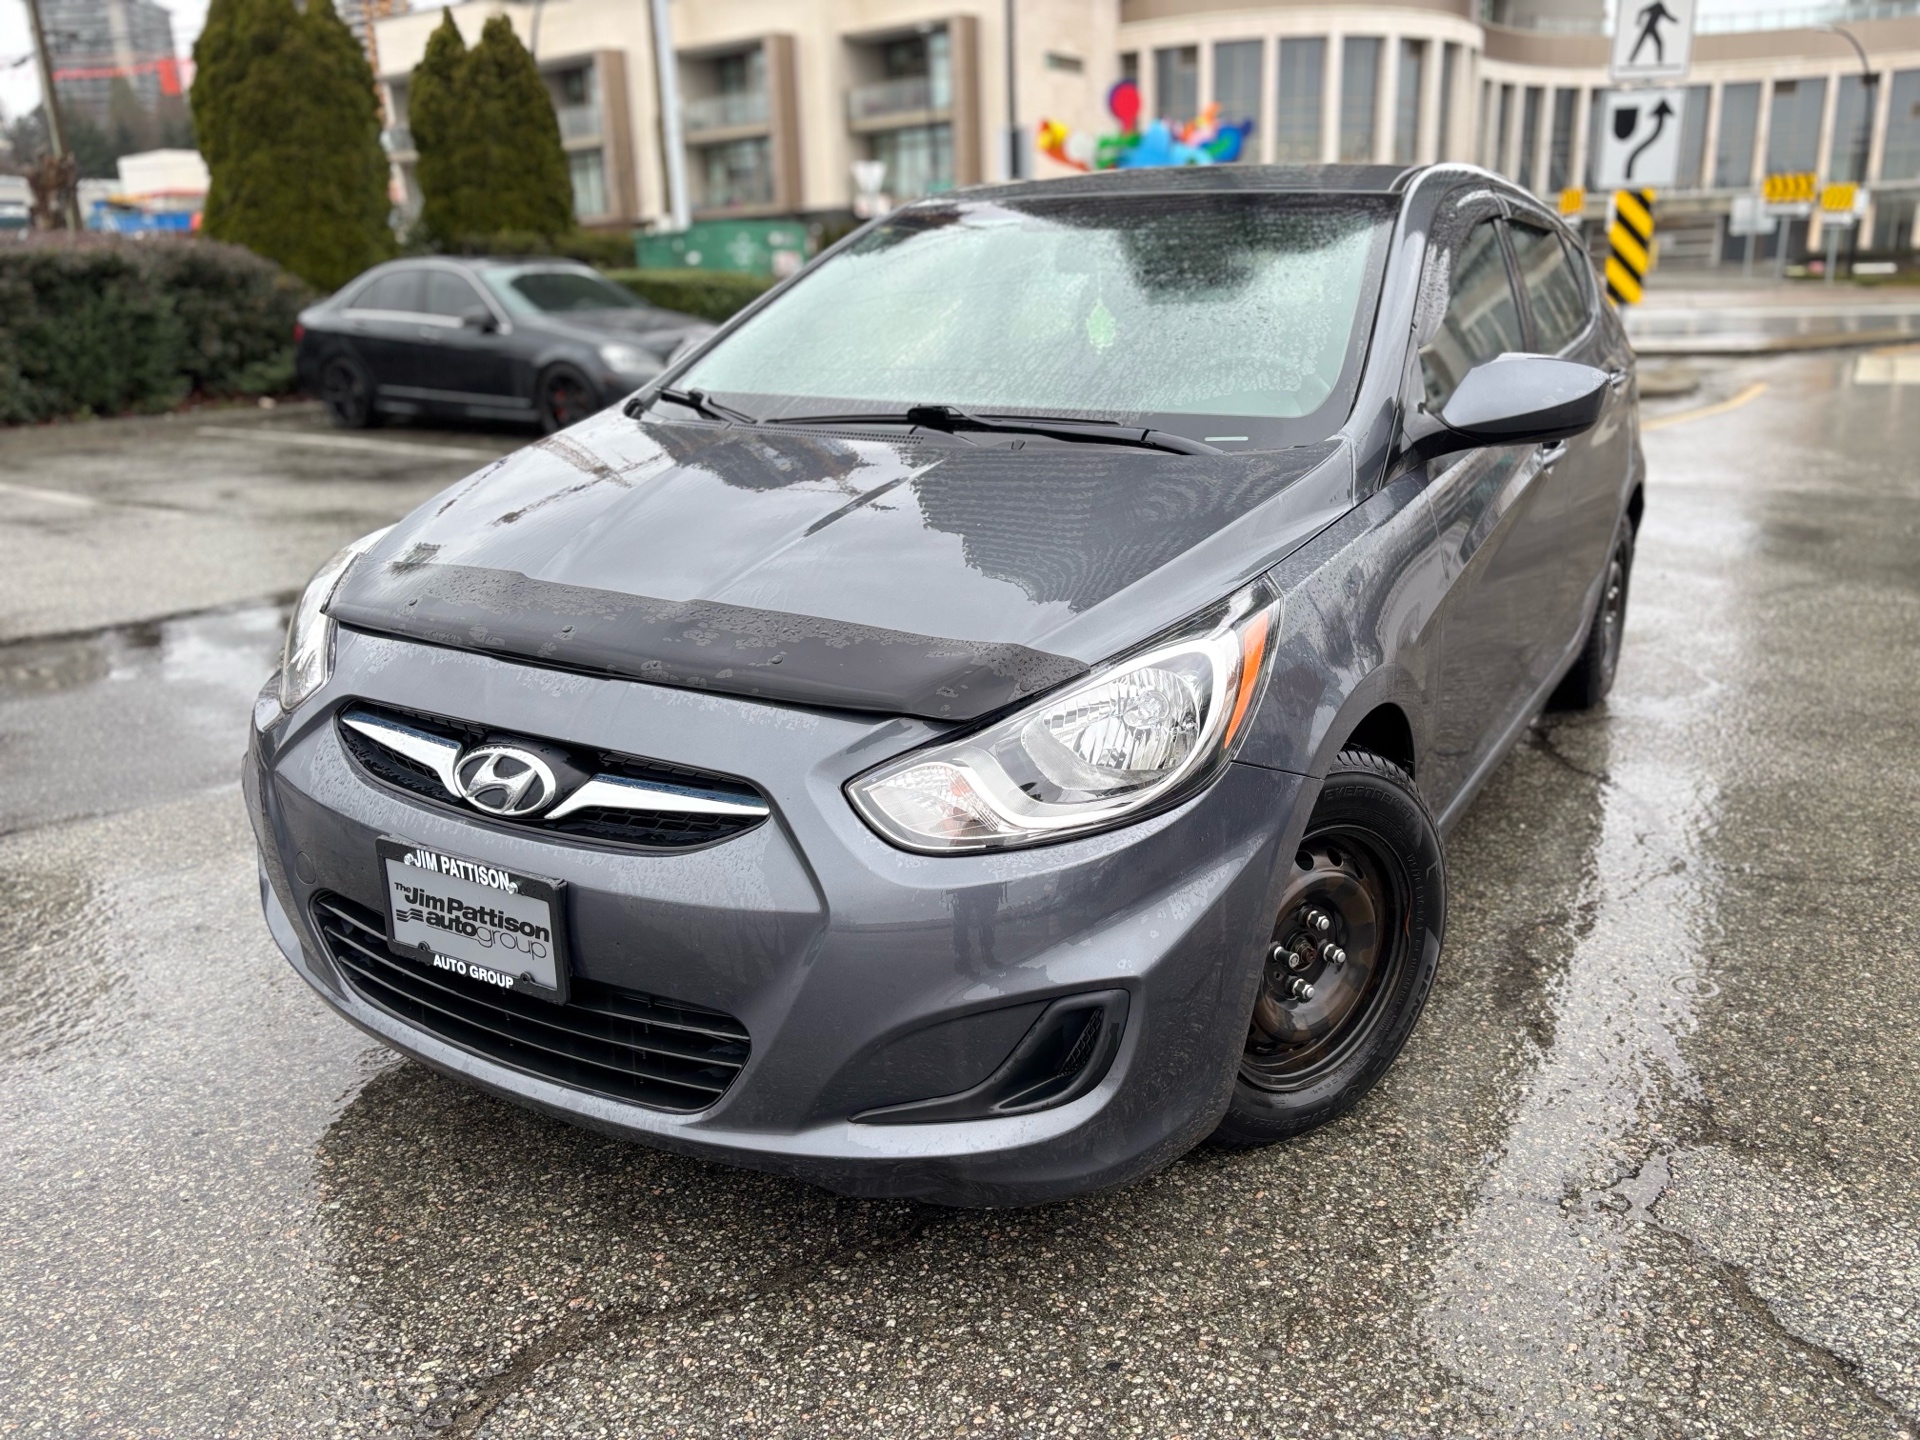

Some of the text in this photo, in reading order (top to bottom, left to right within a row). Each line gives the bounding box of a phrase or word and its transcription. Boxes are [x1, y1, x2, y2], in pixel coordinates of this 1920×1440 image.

[394, 881, 412, 894] The
[414, 849, 510, 892] JIM PATTISON
[404, 886, 550, 943] Jim Pattison
[433, 954, 514, 989] AUTO GROUP
